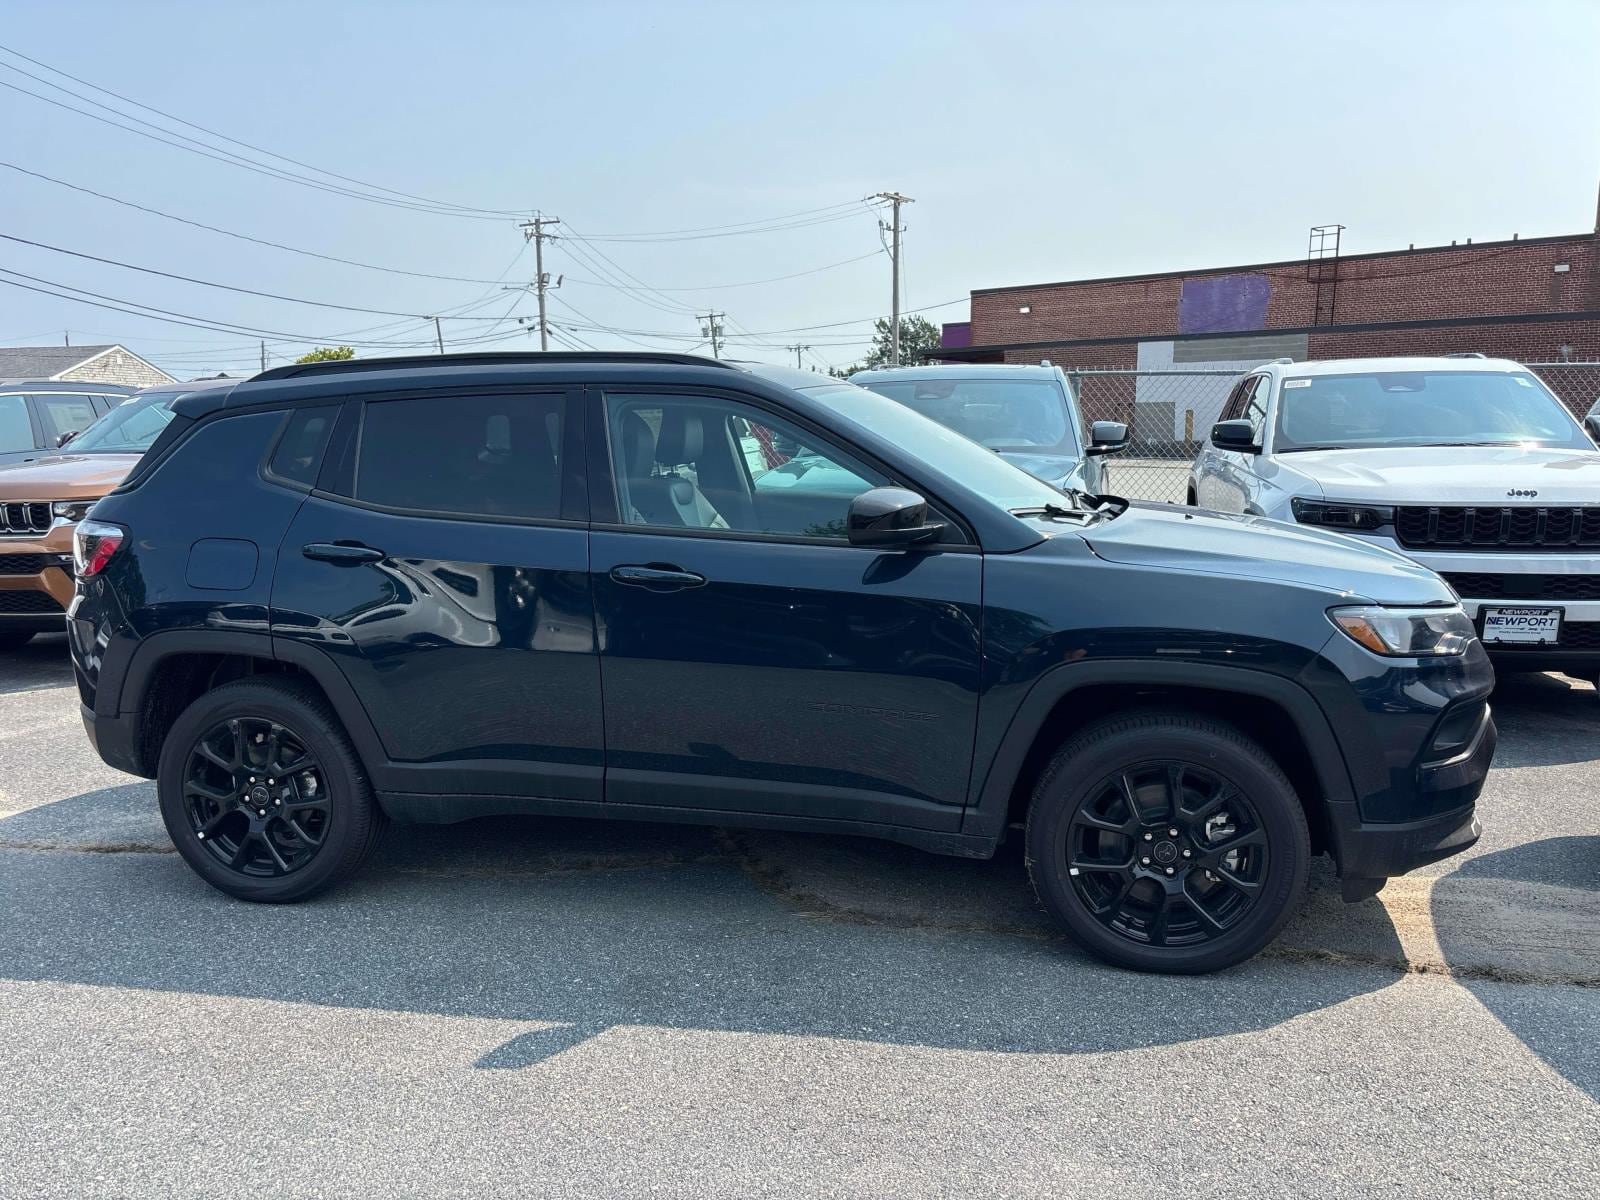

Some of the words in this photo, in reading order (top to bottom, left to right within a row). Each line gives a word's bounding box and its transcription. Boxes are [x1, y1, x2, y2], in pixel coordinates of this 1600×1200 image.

[1507, 488, 1538, 498] Jeep
[1501, 608, 1547, 616] NEWPORT
[1486, 616, 1557, 627] NEWPORT
